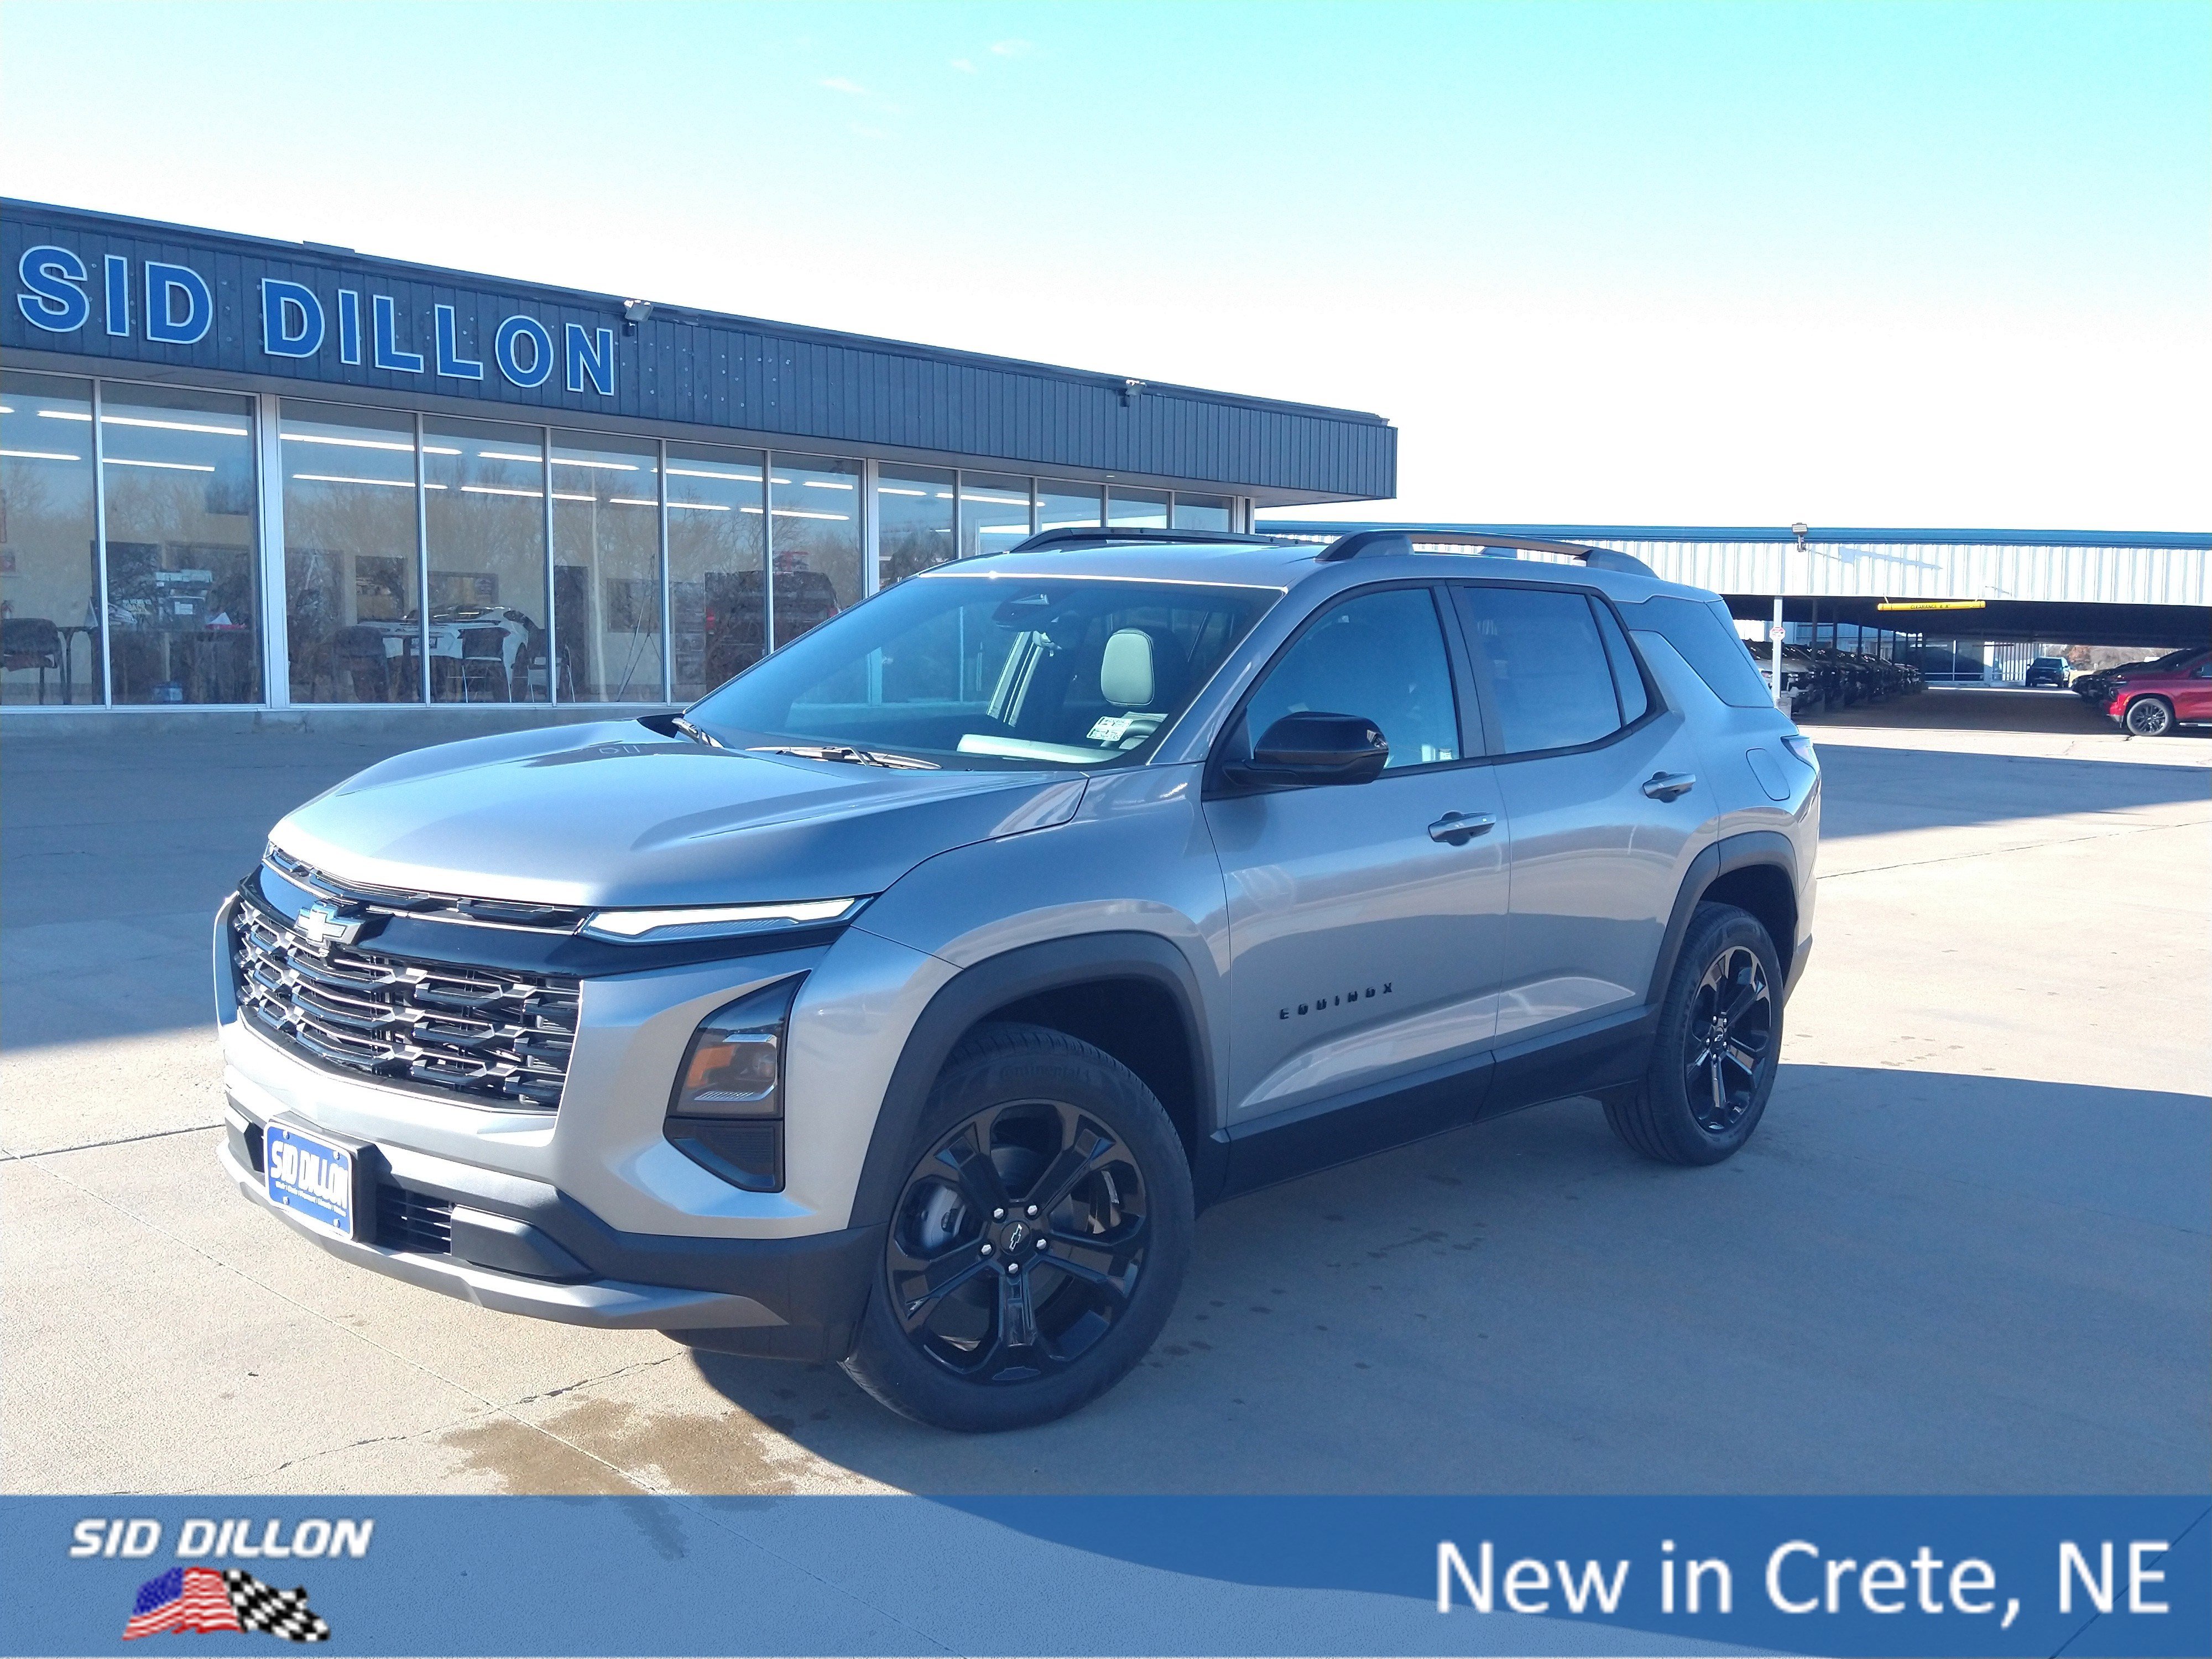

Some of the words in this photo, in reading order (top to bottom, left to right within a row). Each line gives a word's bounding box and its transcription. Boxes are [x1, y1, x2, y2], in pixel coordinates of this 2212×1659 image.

[17, 245, 213, 345] SID
[261, 278, 615, 397] DILLON
[1279, 981, 1392, 1020] EQUINOX
[270, 1140, 298, 1185] SID
[298, 1150, 348, 1209] DILLON
